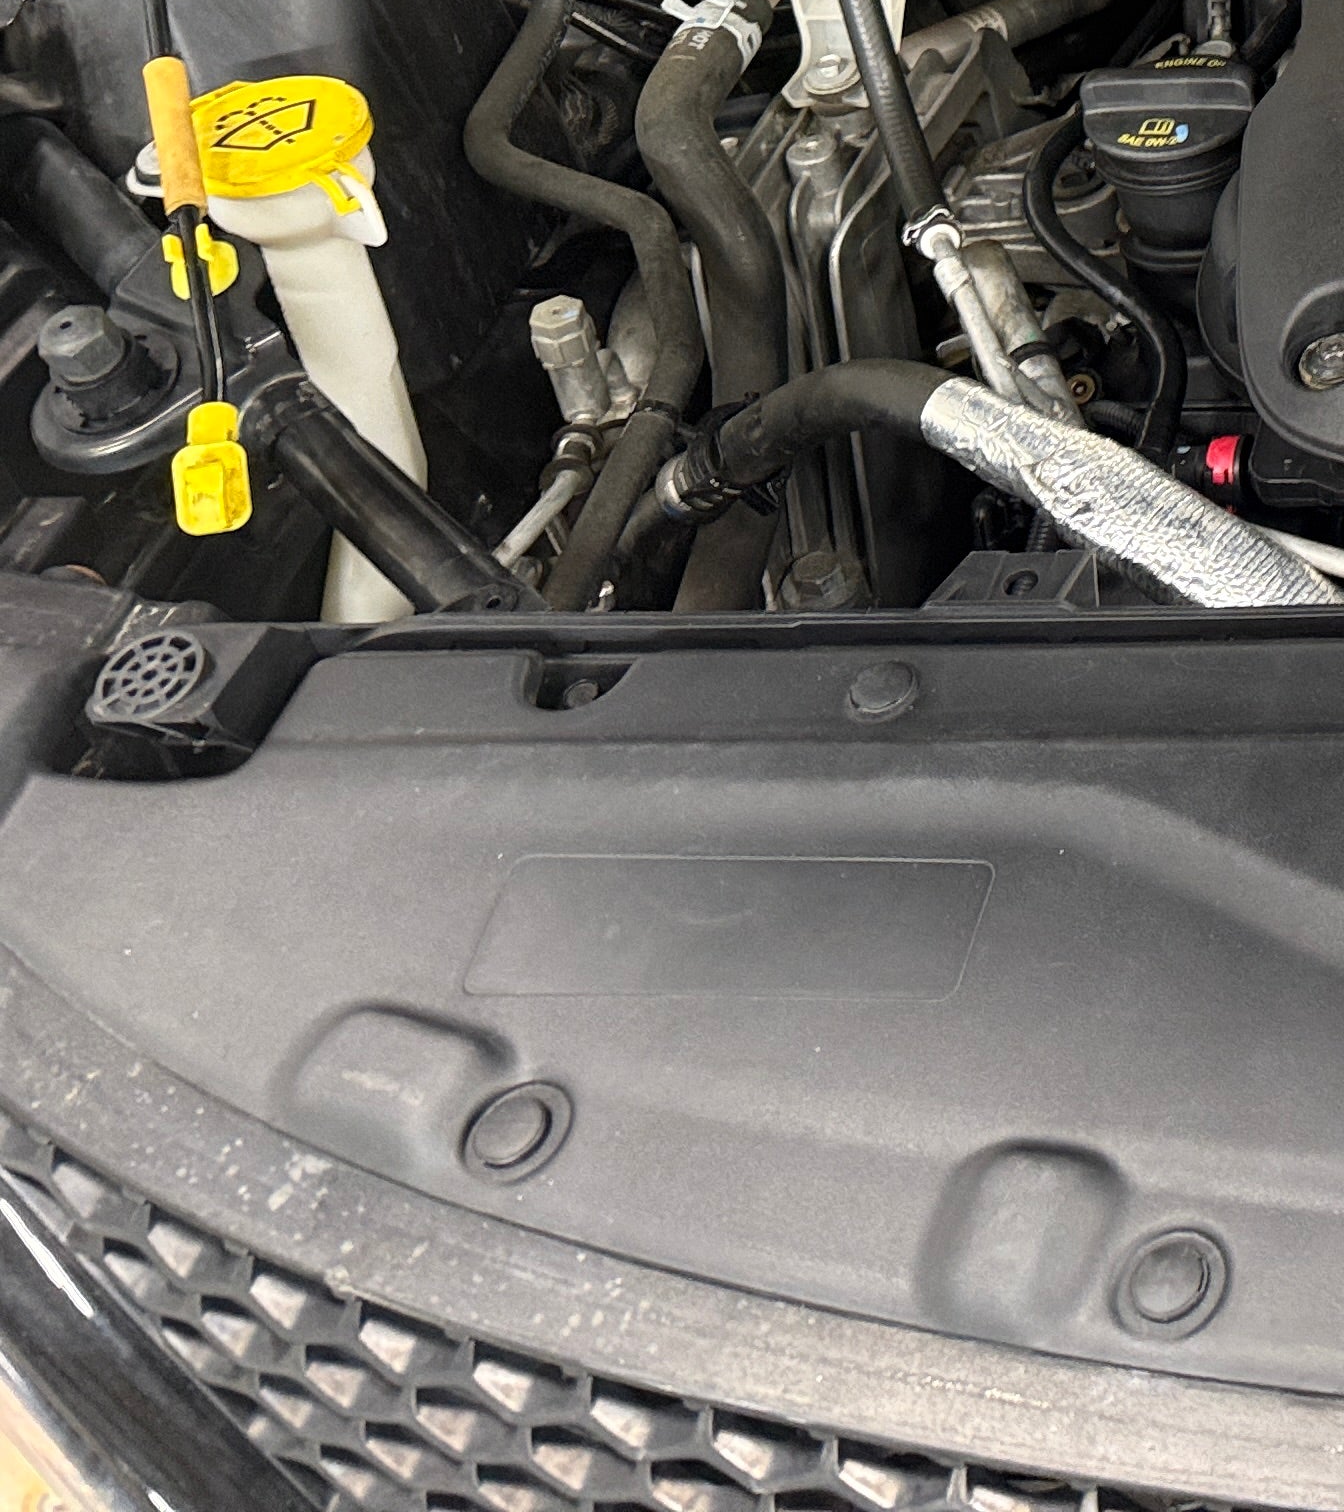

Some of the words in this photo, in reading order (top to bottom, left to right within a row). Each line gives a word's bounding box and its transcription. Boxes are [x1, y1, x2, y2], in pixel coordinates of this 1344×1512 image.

[1154, 57, 1205, 70] ENGINE
[1117, 133, 1143, 147] SAE
[1144, 136, 1181, 148] 0W-2
